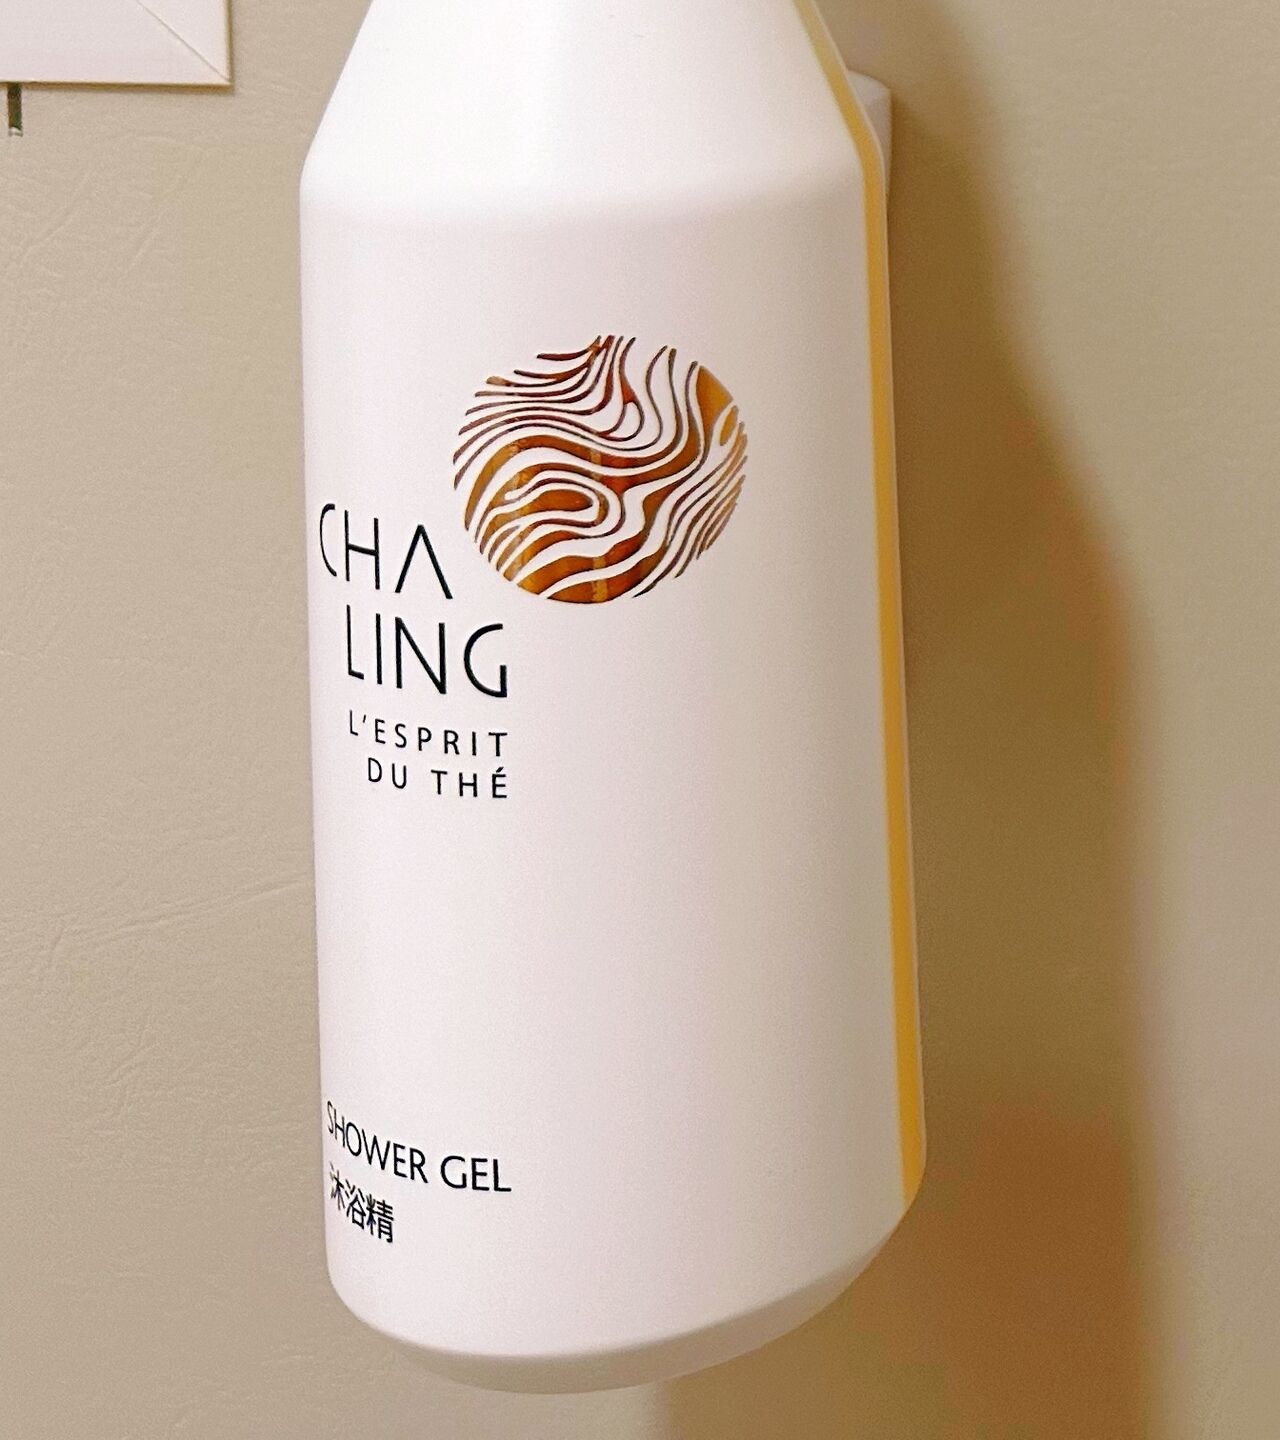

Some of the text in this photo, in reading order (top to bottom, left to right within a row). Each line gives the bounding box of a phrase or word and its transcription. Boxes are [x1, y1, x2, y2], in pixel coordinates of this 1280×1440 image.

[320, 503, 453, 599] CHA
[346, 604, 507, 698] LING
[349, 709, 508, 757] L'ESPRIT
[367, 757, 507, 799] DU THÉ
[327, 1100, 512, 1192] SHOWER GEL
